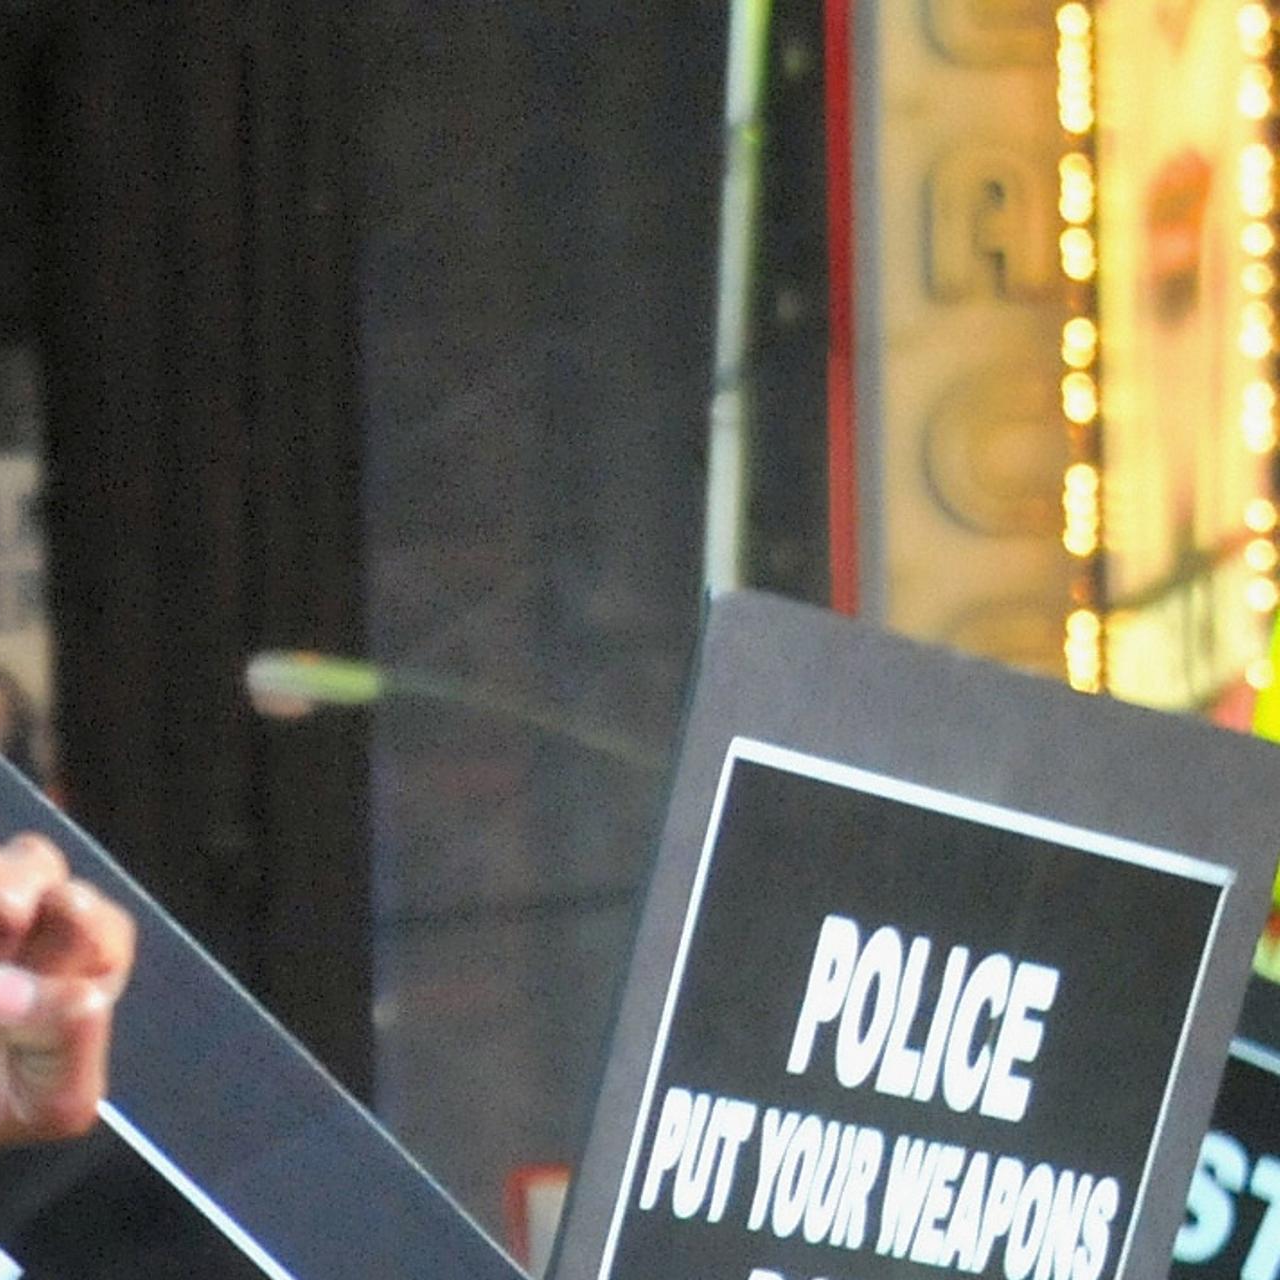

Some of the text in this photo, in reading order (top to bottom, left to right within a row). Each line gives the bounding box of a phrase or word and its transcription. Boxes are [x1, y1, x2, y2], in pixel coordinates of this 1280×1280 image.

[786, 914, 1060, 1122] POLICE
[639, 1087, 757, 1224] PUT
[747, 1108, 884, 1250] YOUR
